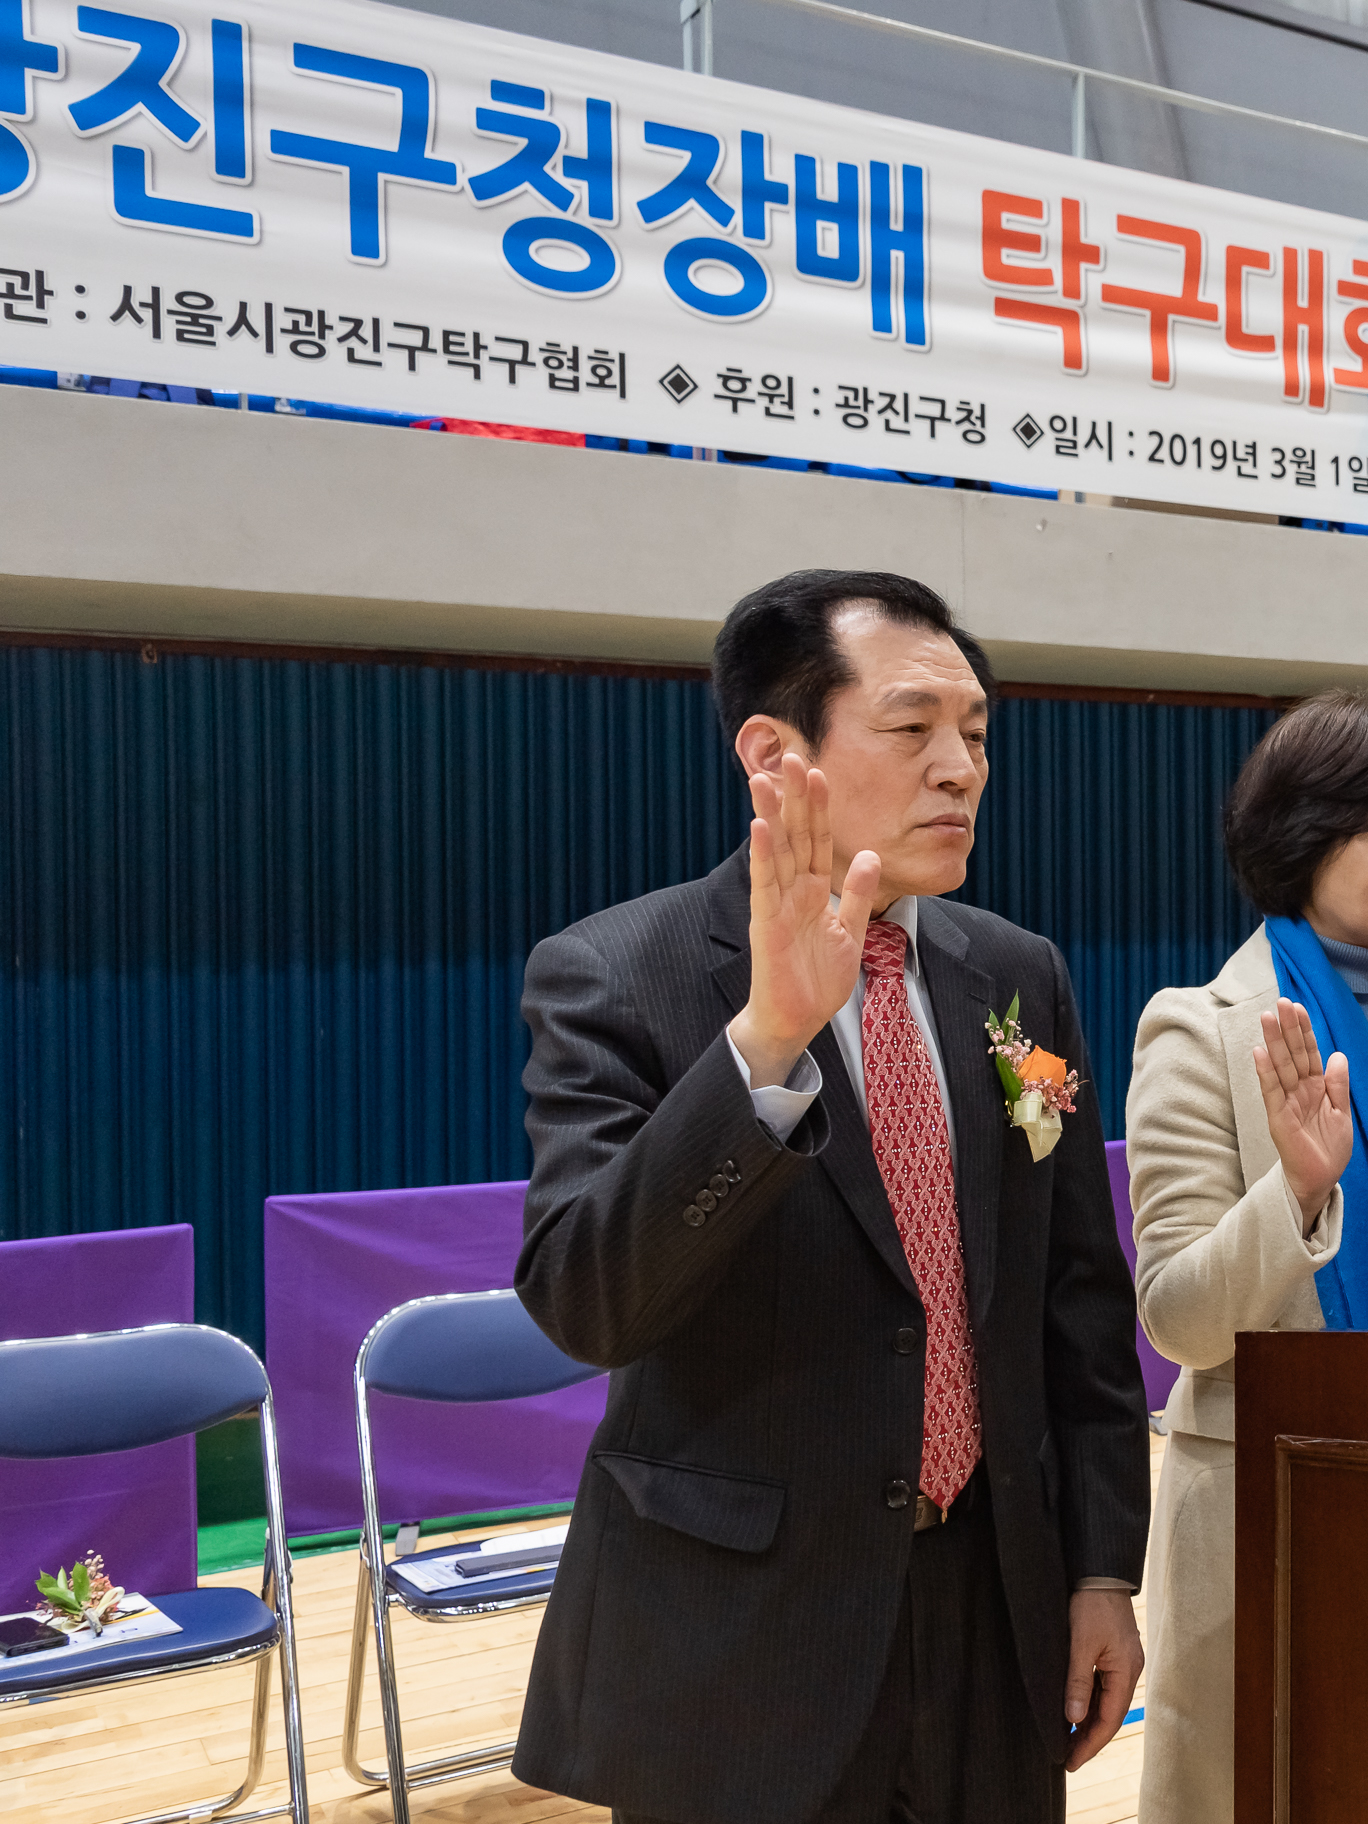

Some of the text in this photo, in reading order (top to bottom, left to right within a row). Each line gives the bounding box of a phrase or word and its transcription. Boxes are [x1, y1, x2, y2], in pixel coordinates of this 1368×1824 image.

[110, 284, 627, 400] 서울시광진구탁구협회
[713, 367, 796, 420] 후원
[834, 384, 987, 444] 광진구청
[1049, 414, 1114, 462] 일시
[1147, 430, 1259, 480] 2019년
[1270, 447, 1317, 488] 3월
